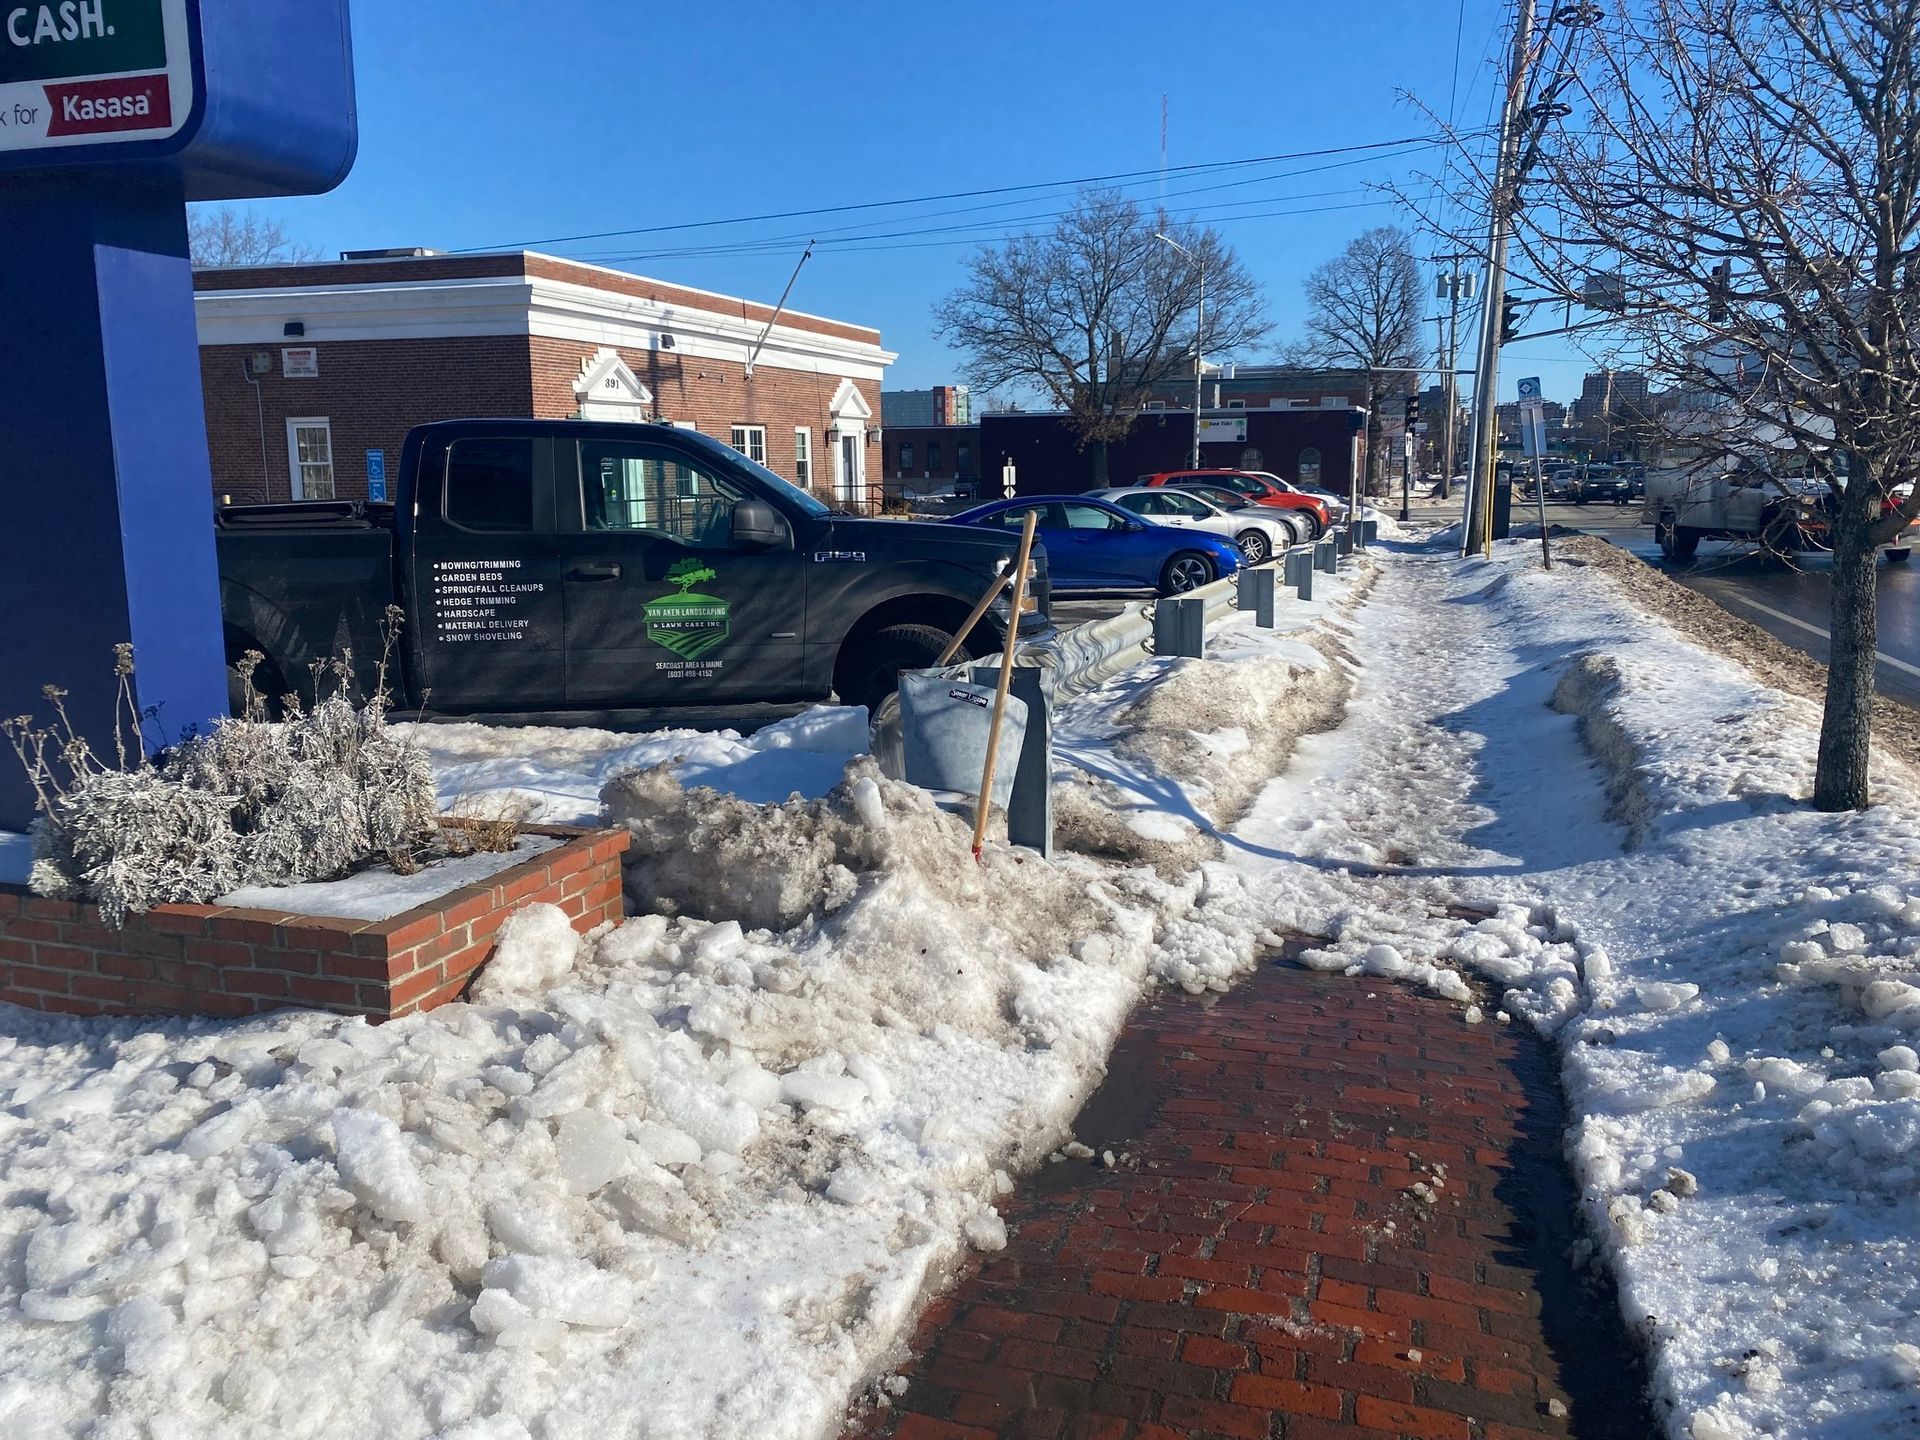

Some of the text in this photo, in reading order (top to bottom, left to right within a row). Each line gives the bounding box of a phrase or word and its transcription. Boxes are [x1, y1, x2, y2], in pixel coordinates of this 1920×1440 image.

[7, 0, 115, 46] CASH.
[14, 104, 38, 125] for
[605, 378, 619, 389] 391
[441, 560, 521, 570] MOWING/TRIMMING
[441, 573, 503, 582] GARDEN BEDS
[442, 583, 544, 594] SPRING/FALL CLEANUPS
[443, 596, 517, 606] HEDGE TRIMMING
[444, 609, 496, 618] HARDSCAPE
[648, 607, 726, 617] VAN AKEN LANDSCAPING
[445, 620, 529, 630] MATERIAL DELIVERY
[446, 632, 523, 642] SNOW SHOVELING
[655, 662, 684, 670] SEACOAST
[685, 661, 700, 669] AREA
[706, 660, 724, 668] MAINE
